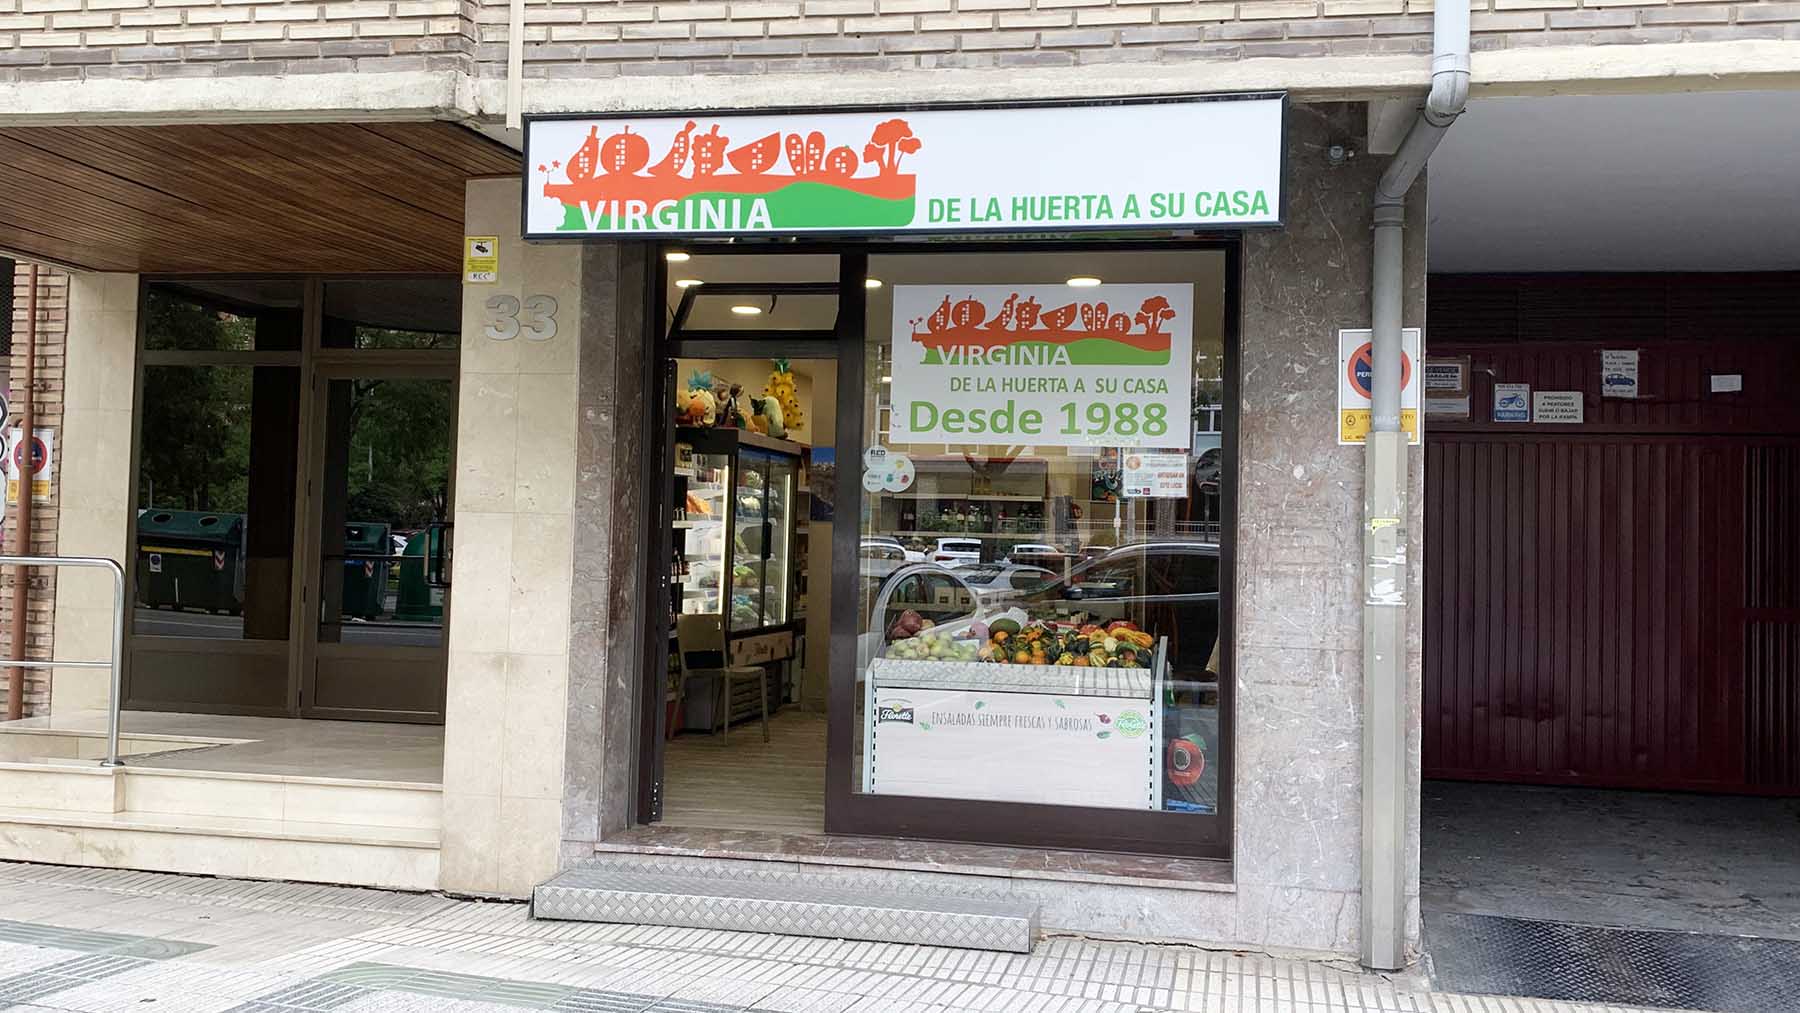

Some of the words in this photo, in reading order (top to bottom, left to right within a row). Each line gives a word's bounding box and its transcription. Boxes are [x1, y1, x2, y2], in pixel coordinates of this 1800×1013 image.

[579, 198, 773, 230] VIRGINIA
[928, 198, 960, 223] DE
[970, 197, 1002, 222] LA
[1011, 194, 1113, 221] HUERTA
[1122, 194, 1141, 219] A
[1150, 191, 1185, 218] SU
[1195, 190, 1268, 217] CASA
[483, 294, 559, 342] 33
[937, 344, 1072, 366] VIRGINIA
[950, 377, 971, 392] DE
[977, 377, 997, 393] LA
[1001, 377, 1069, 393] HUERTA
[1073, 379, 1086, 393] A
[1095, 378, 1118, 394] SU
[1123, 377, 1169, 394] CASA
[909, 400, 1043, 435] Desde
[1060, 401, 1169, 437] 1988
[932, 711, 976, 727] ENSALADAS
[977, 713, 1012, 728] SIEMPRE
[1014, 715, 1046, 730] FRESCAS
[1055, 717, 1093, 731] SABROSAS
